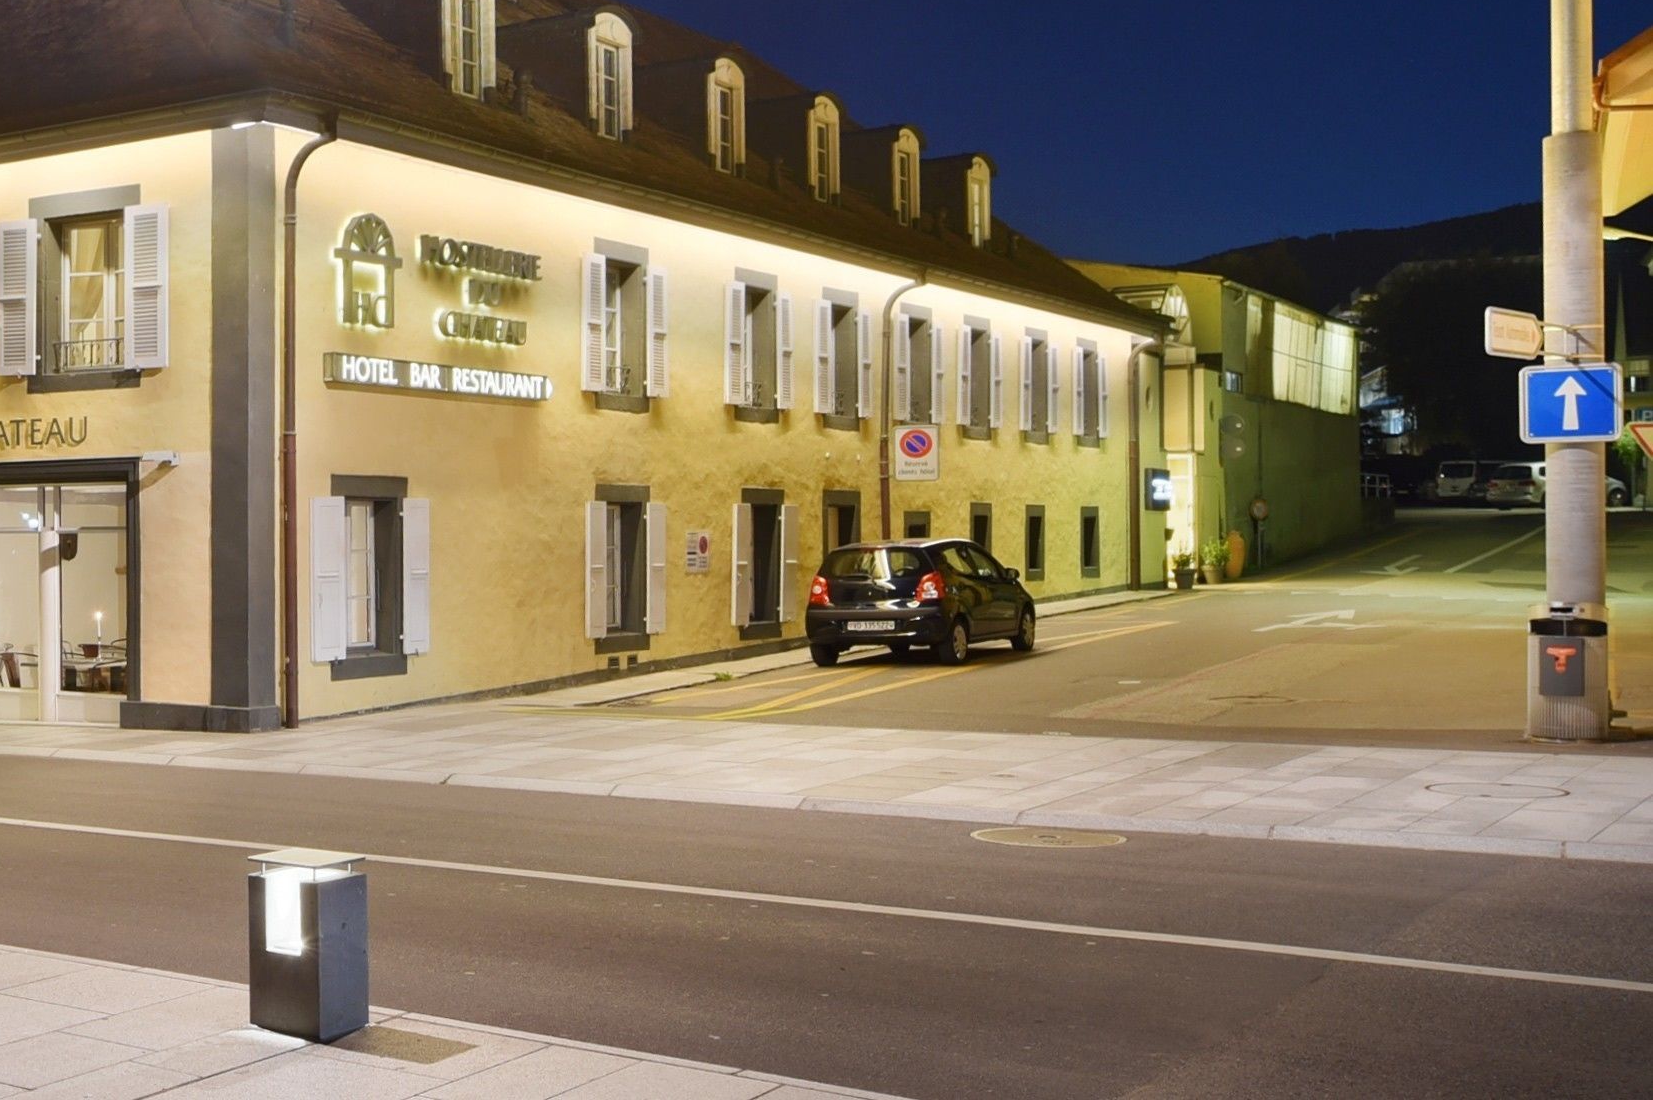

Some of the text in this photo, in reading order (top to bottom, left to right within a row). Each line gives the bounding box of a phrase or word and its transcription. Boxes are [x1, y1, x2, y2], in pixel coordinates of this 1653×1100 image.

[420, 234, 543, 281] HOSTELLERIE
[468, 279, 502, 307] DU
[438, 311, 527, 346] CHATEAU
[342, 355, 544, 399] HOTEL BAR RESTAURANT
